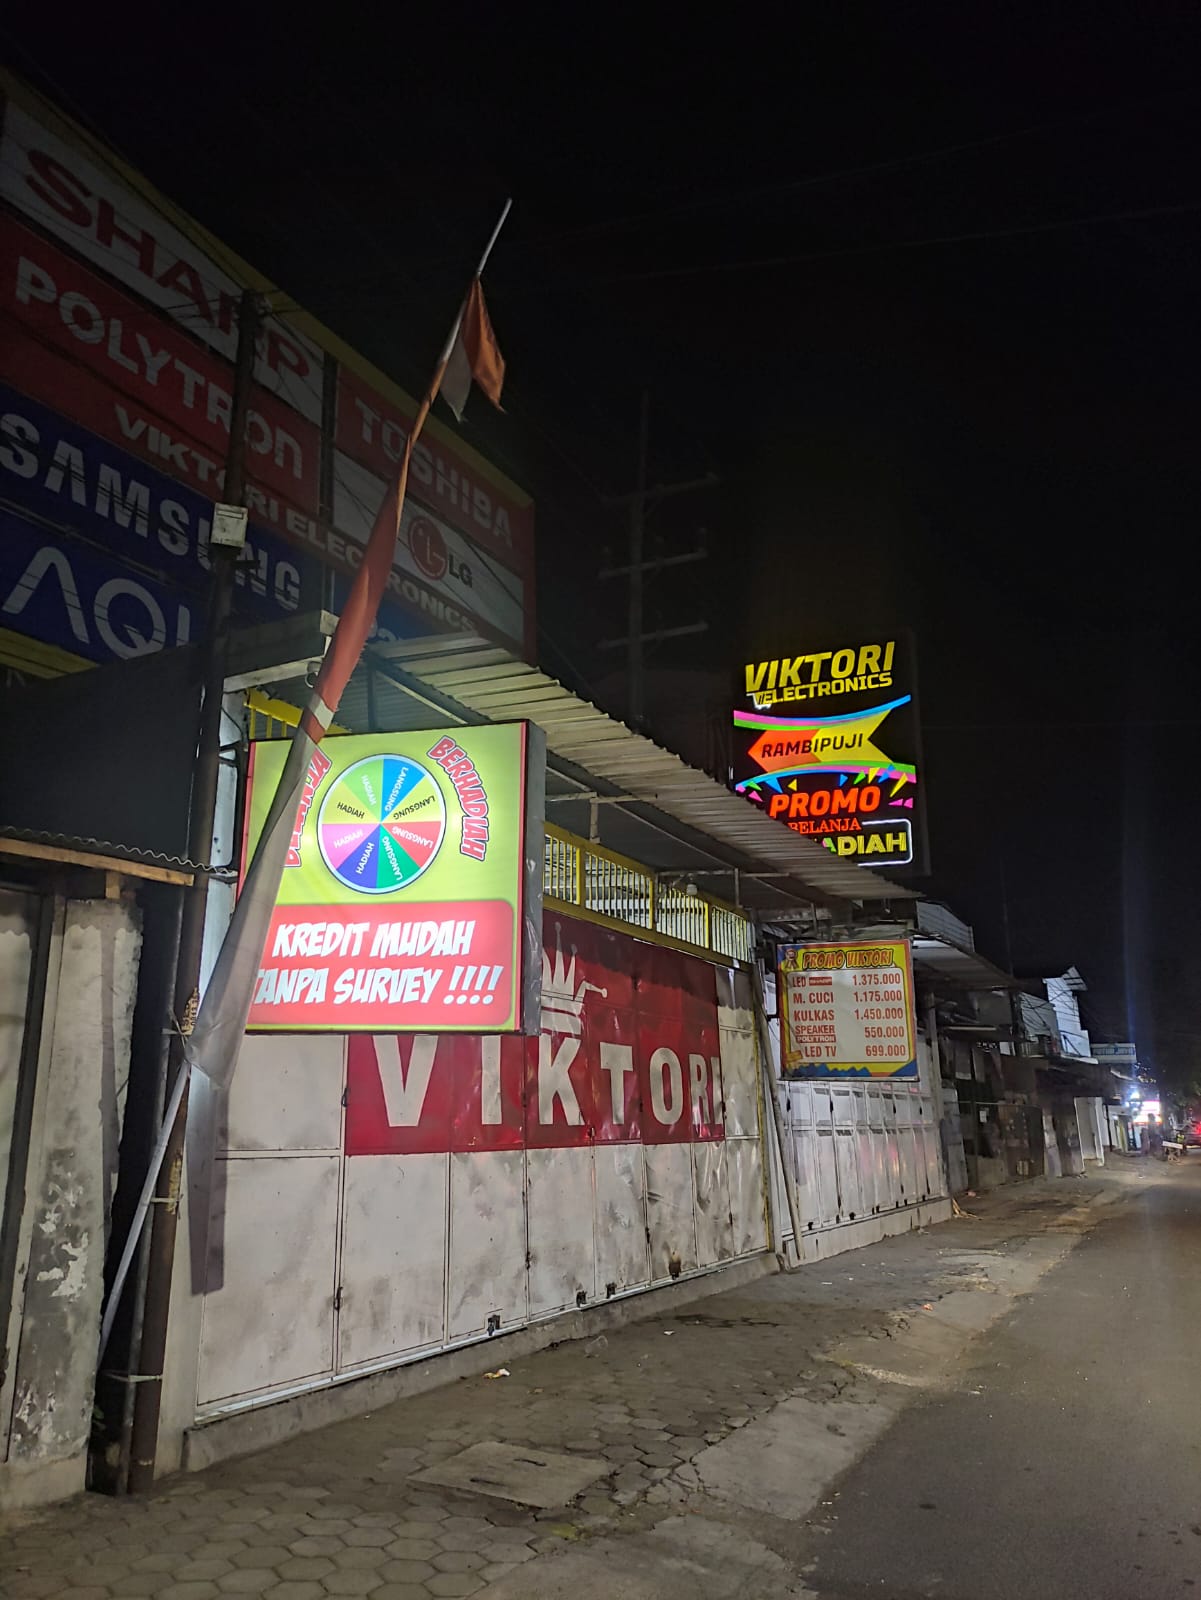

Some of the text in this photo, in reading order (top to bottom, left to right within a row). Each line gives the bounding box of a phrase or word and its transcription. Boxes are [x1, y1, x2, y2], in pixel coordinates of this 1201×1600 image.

[354, 398, 514, 548] TOSHIBA
[286, 513, 477, 632] ELECRONICS
[744, 641, 896, 693] VIKTORI
[757, 671, 893, 705] ELECTRONICS
[761, 733, 863, 758] RAMBIPUJI
[384, 766, 409, 812] LANGSUNG
[428, 736, 488, 861] BERHADIAH
[336, 801, 366, 819] HADIAH
[393, 795, 436, 820] LANGSUNG
[769, 785, 882, 819] PROMO
[391, 825, 434, 849] LANGSUNG
[355, 842, 375, 875] HADIAH
[381, 835, 404, 881] LANGSUNG
[271, 920, 476, 958] KREDIT MUDAH
[803, 949, 894, 969] PROMO VIKTORI
[333, 967, 443, 1005] SURVEY
[443, 965, 504, 1005] !!!!
[792, 976, 807, 988] LED
[852, 973, 901, 986] 1.375.000
[792, 991, 834, 1005] M. CUCI
[853, 990, 902, 1003] 1.175.000
[794, 1009, 835, 1022] KULKAS
[854, 1008, 904, 1021] 1.450.000
[794, 1025, 836, 1035] SPEAKER
[864, 1026, 905, 1038] 550.000
[804, 1046, 837, 1058] LED TV
[865, 1045, 906, 1057] 699.000
[372, 1034, 722, 1127] VIKTORI
